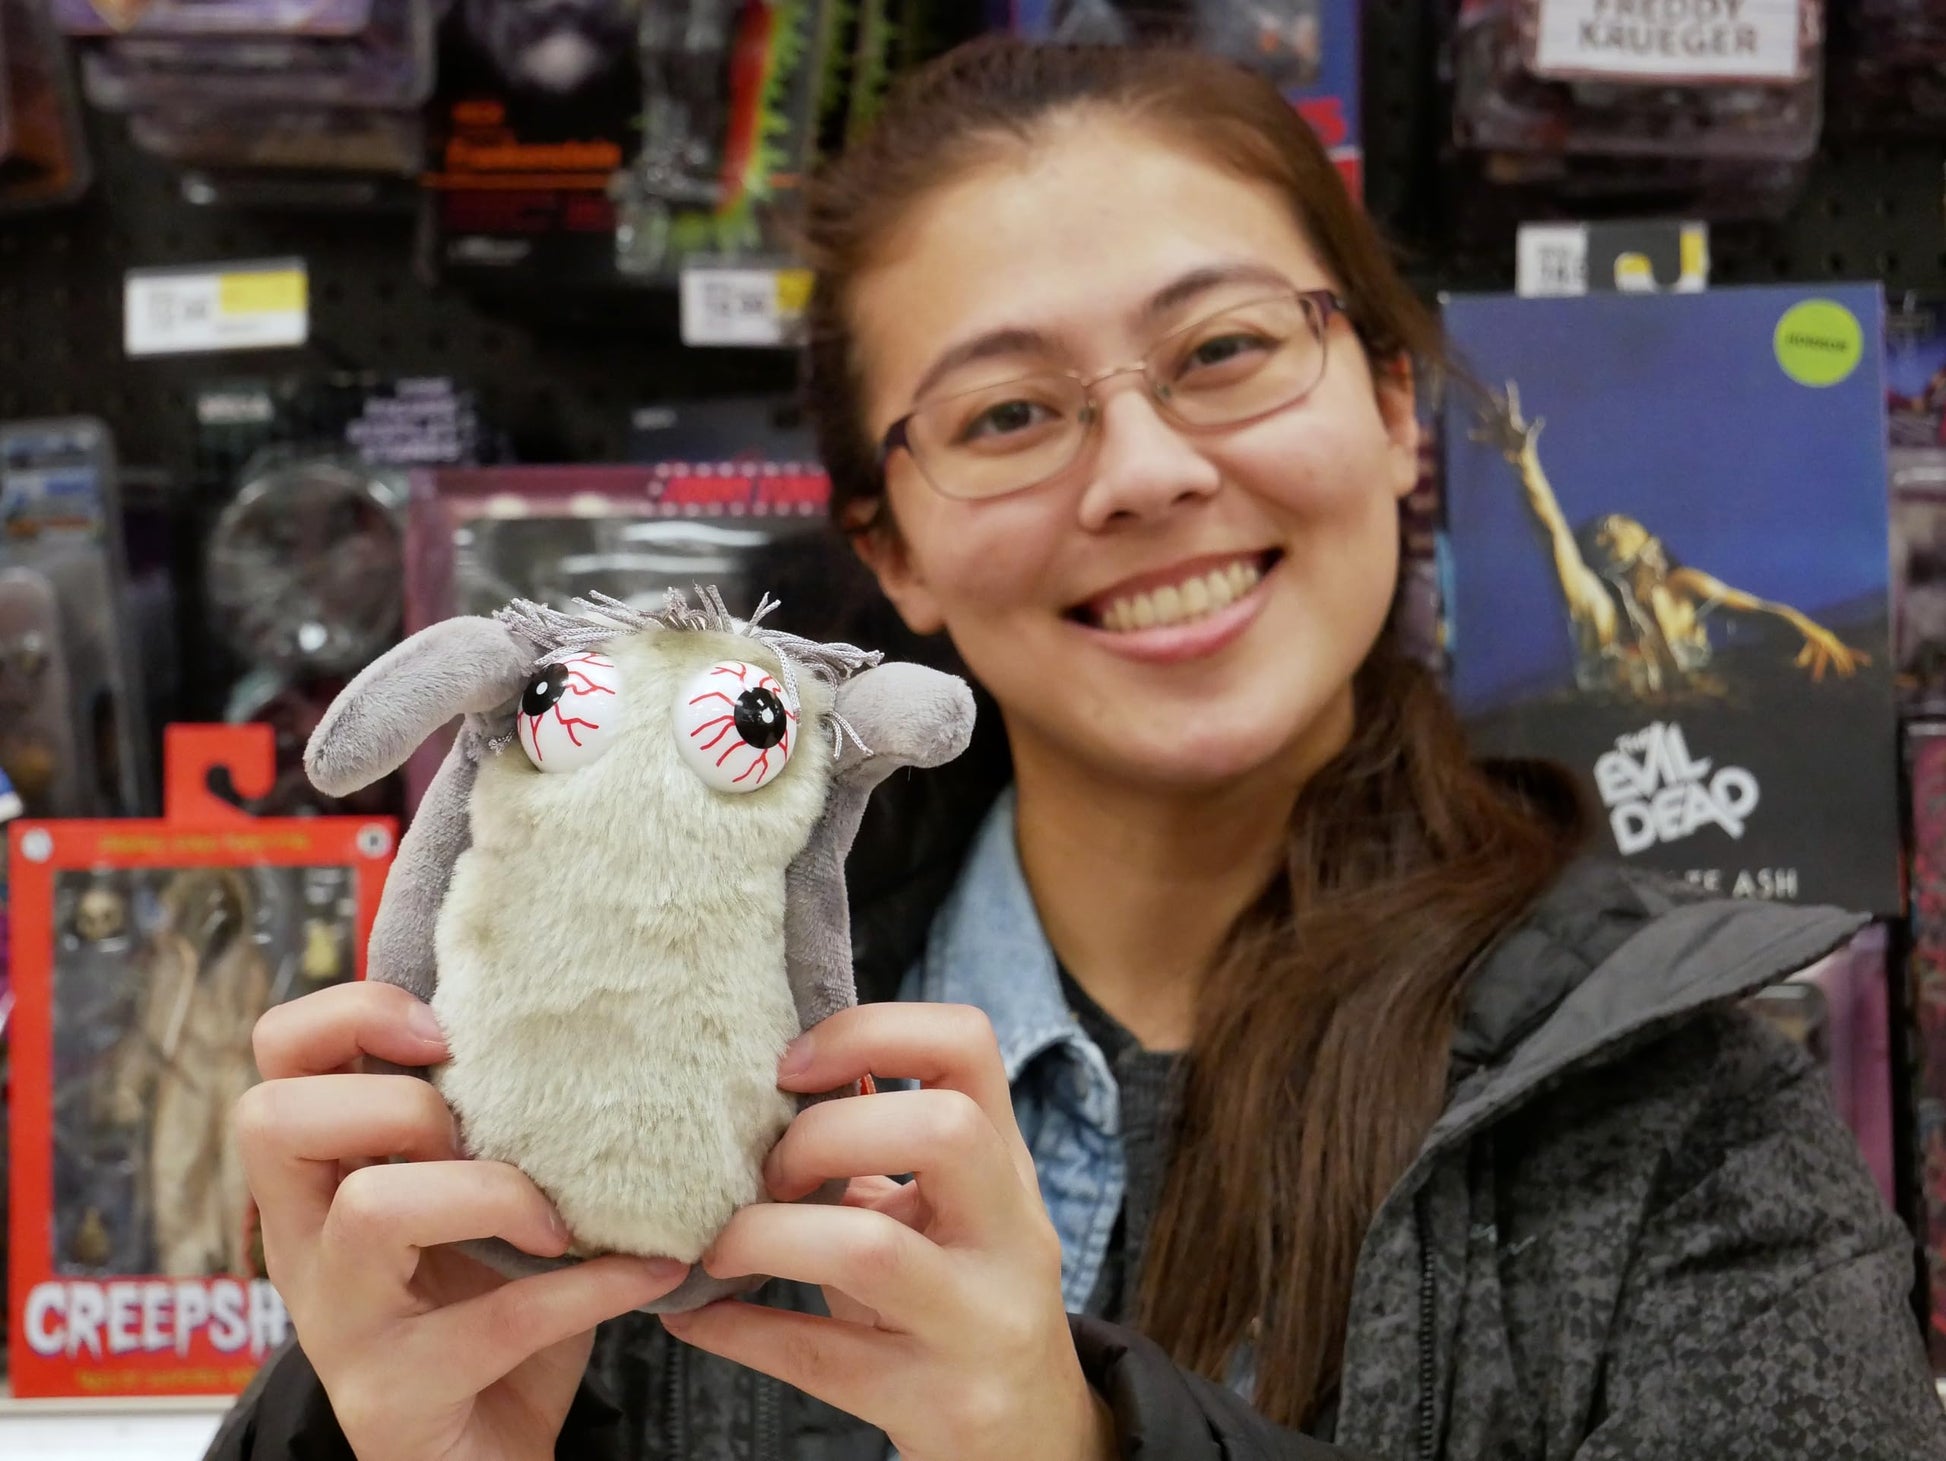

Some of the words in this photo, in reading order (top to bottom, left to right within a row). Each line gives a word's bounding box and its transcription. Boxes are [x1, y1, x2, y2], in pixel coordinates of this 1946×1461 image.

[1578, 19, 1759, 57] KRUEGER
[1593, 720, 1712, 808] EVIL
[1609, 765, 1760, 857] DEAD
[1731, 867, 1798, 899] ASH
